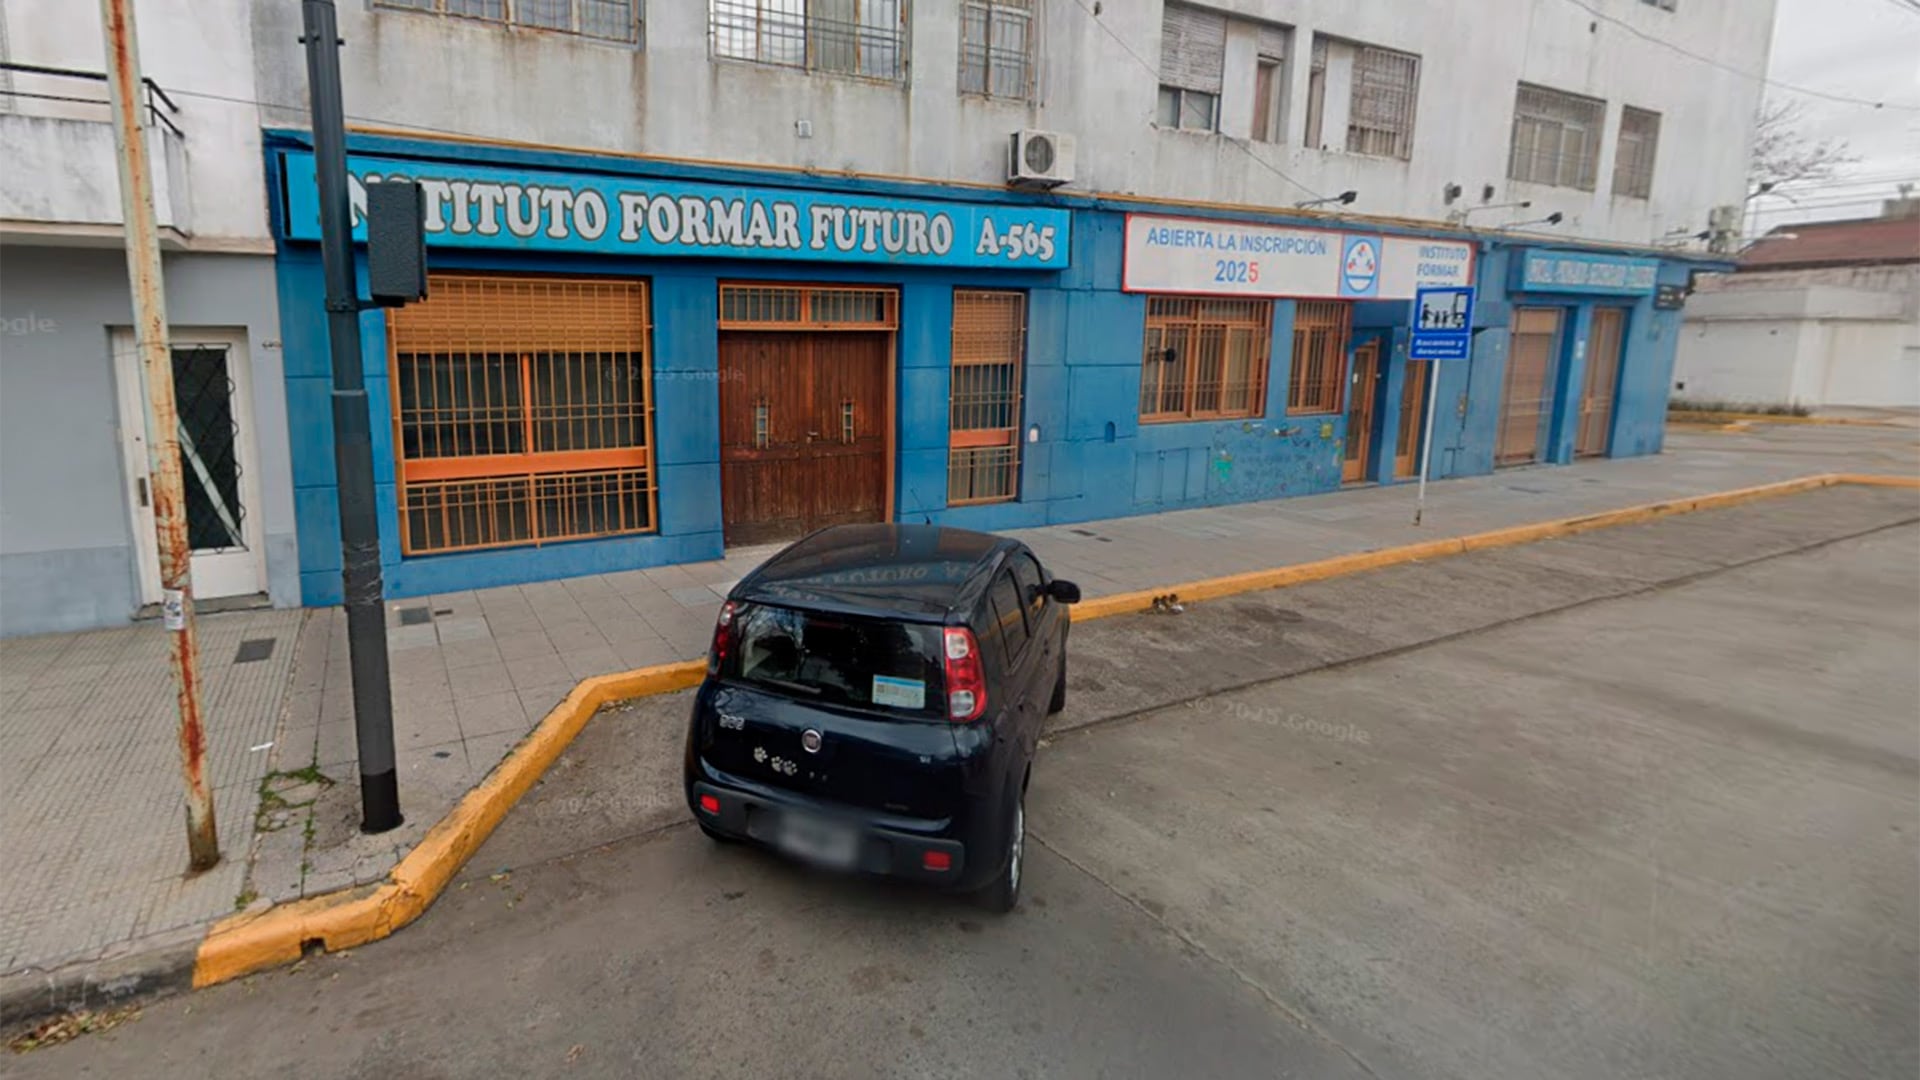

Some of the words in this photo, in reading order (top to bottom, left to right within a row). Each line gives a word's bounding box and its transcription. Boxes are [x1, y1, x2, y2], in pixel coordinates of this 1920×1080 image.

[619, 193, 802, 249] FORMAR
[809, 204, 954, 255] FUTURO
[975, 217, 1056, 261] A-565
[1146, 227, 1214, 250] ABIERTA
[1217, 234, 1237, 251] LA
[1240, 234, 1327, 256] INSCRIPCIÓN
[1214, 259, 1260, 284] 2025
